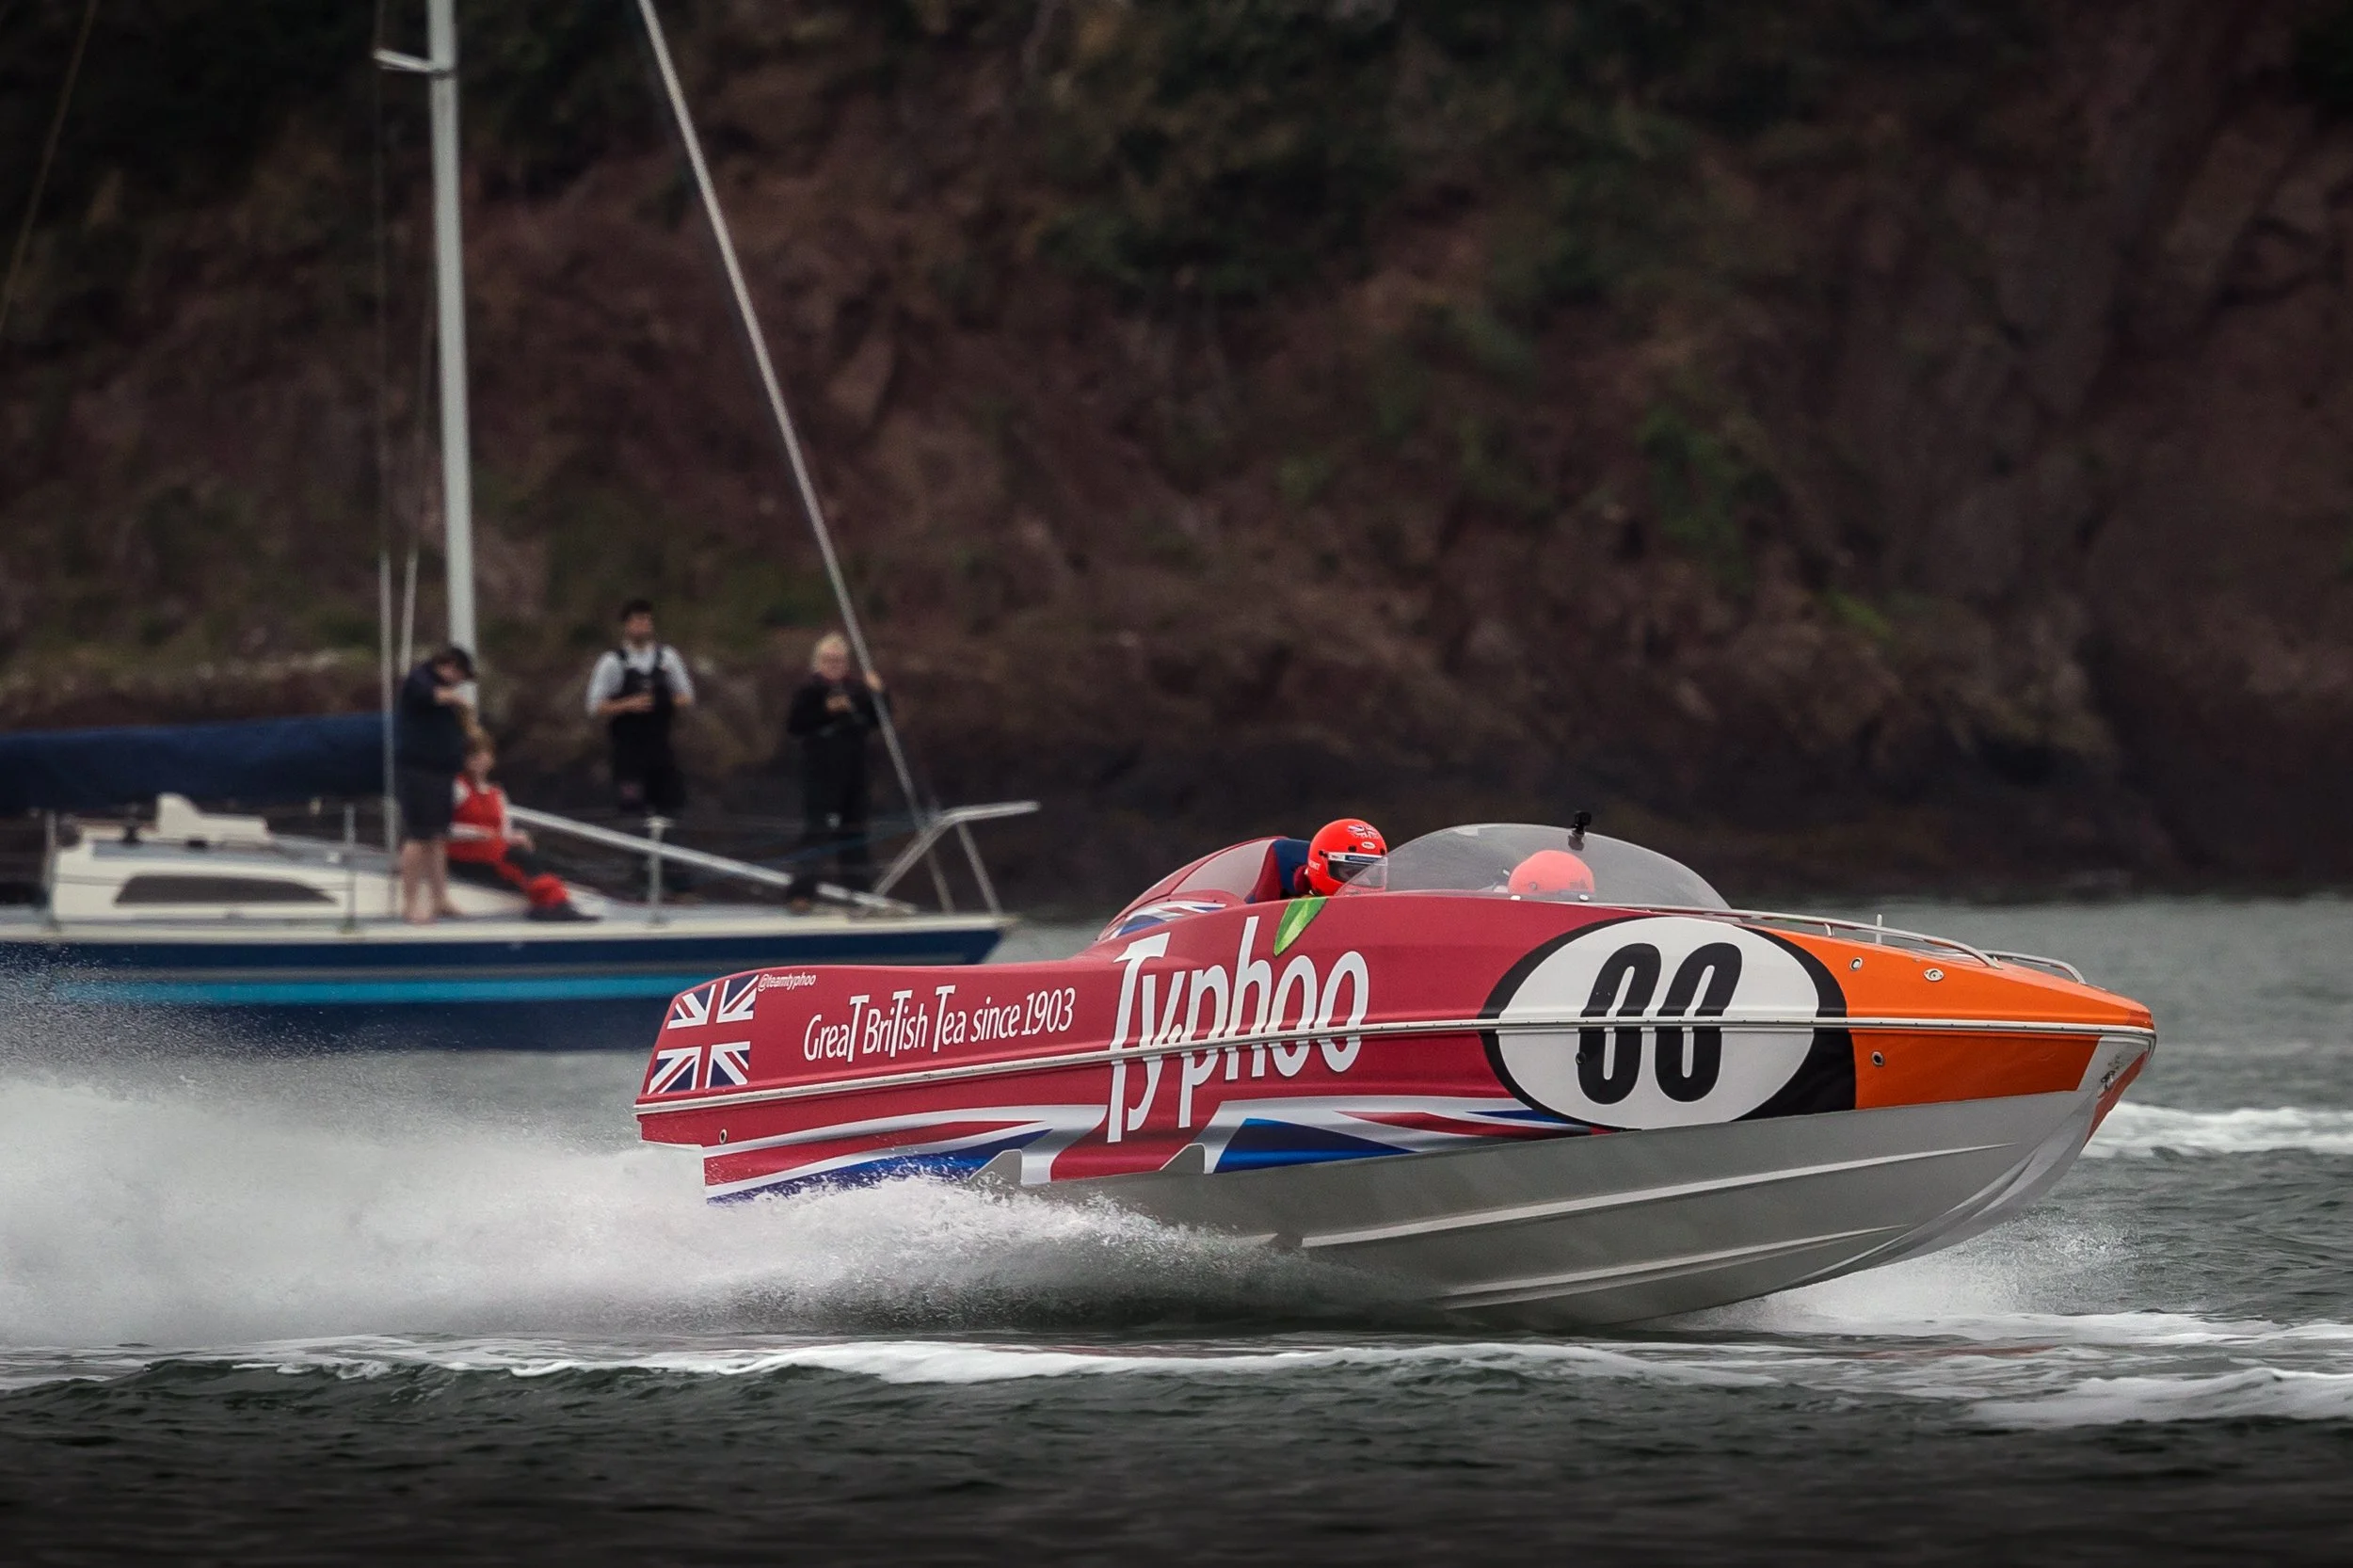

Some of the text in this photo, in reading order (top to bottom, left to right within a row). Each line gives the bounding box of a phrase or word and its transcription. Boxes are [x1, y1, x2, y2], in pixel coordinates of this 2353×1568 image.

[758, 972, 817, 992] @teamtyphoo
[932, 984, 968, 1053] Tea
[970, 996, 1020, 1043] since
[1021, 987, 1076, 1036] 1903
[1107, 915, 1369, 1143] Typhoo
[1577, 942, 1743, 1105] 00
